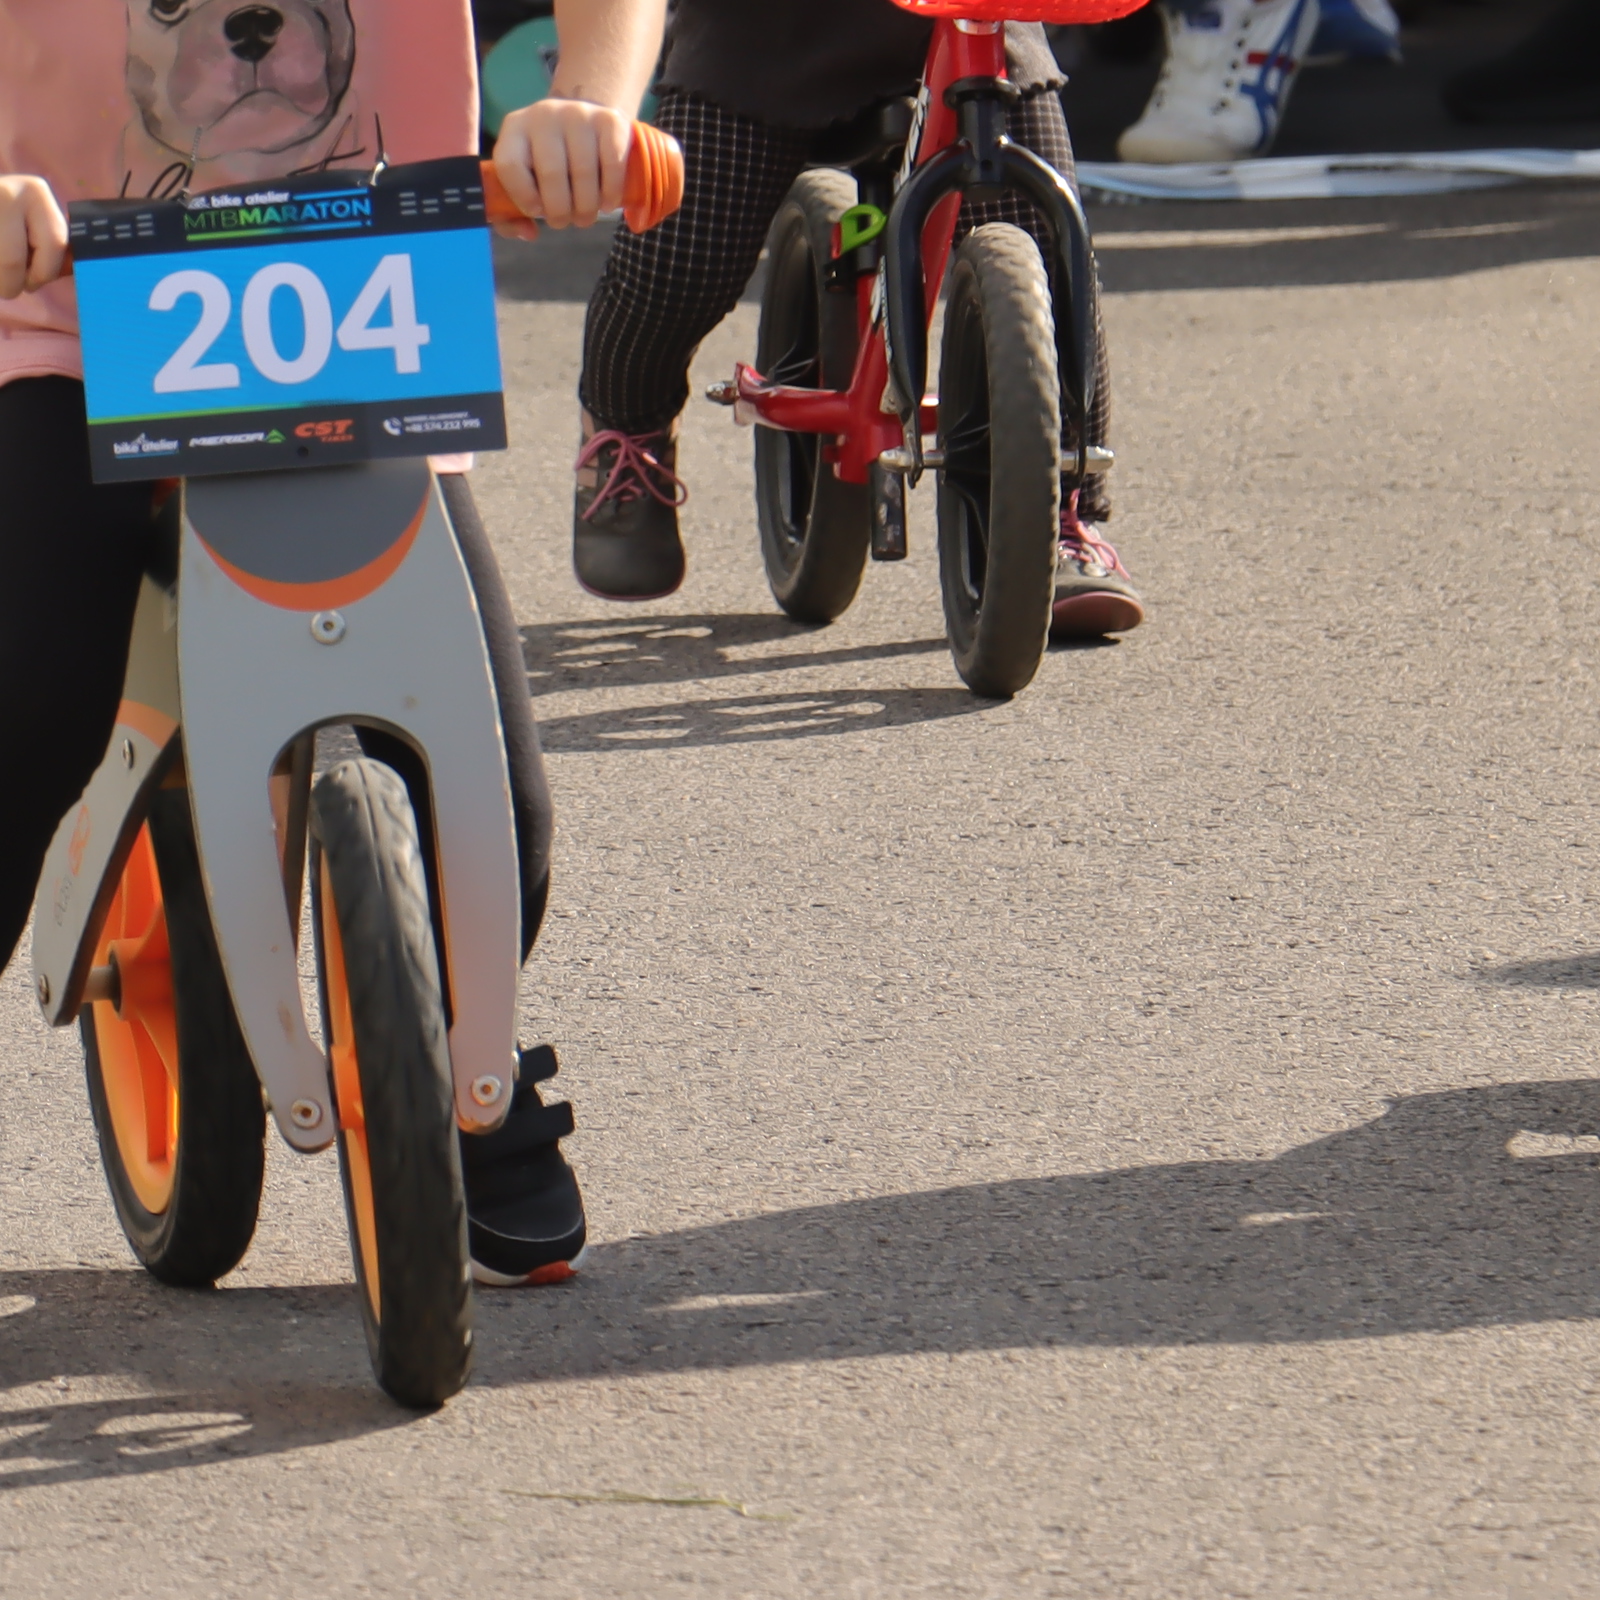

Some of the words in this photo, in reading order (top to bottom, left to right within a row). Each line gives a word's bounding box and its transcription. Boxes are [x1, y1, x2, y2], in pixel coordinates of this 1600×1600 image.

[211, 195, 242, 208] bike
[245, 191, 290, 206] atelier
[184, 198, 371, 230] MTBMARATON
[148, 253, 430, 394] 204
[294, 419, 353, 438] CST
[113, 442, 139, 455] bike
[142, 438, 179, 452] atelier
